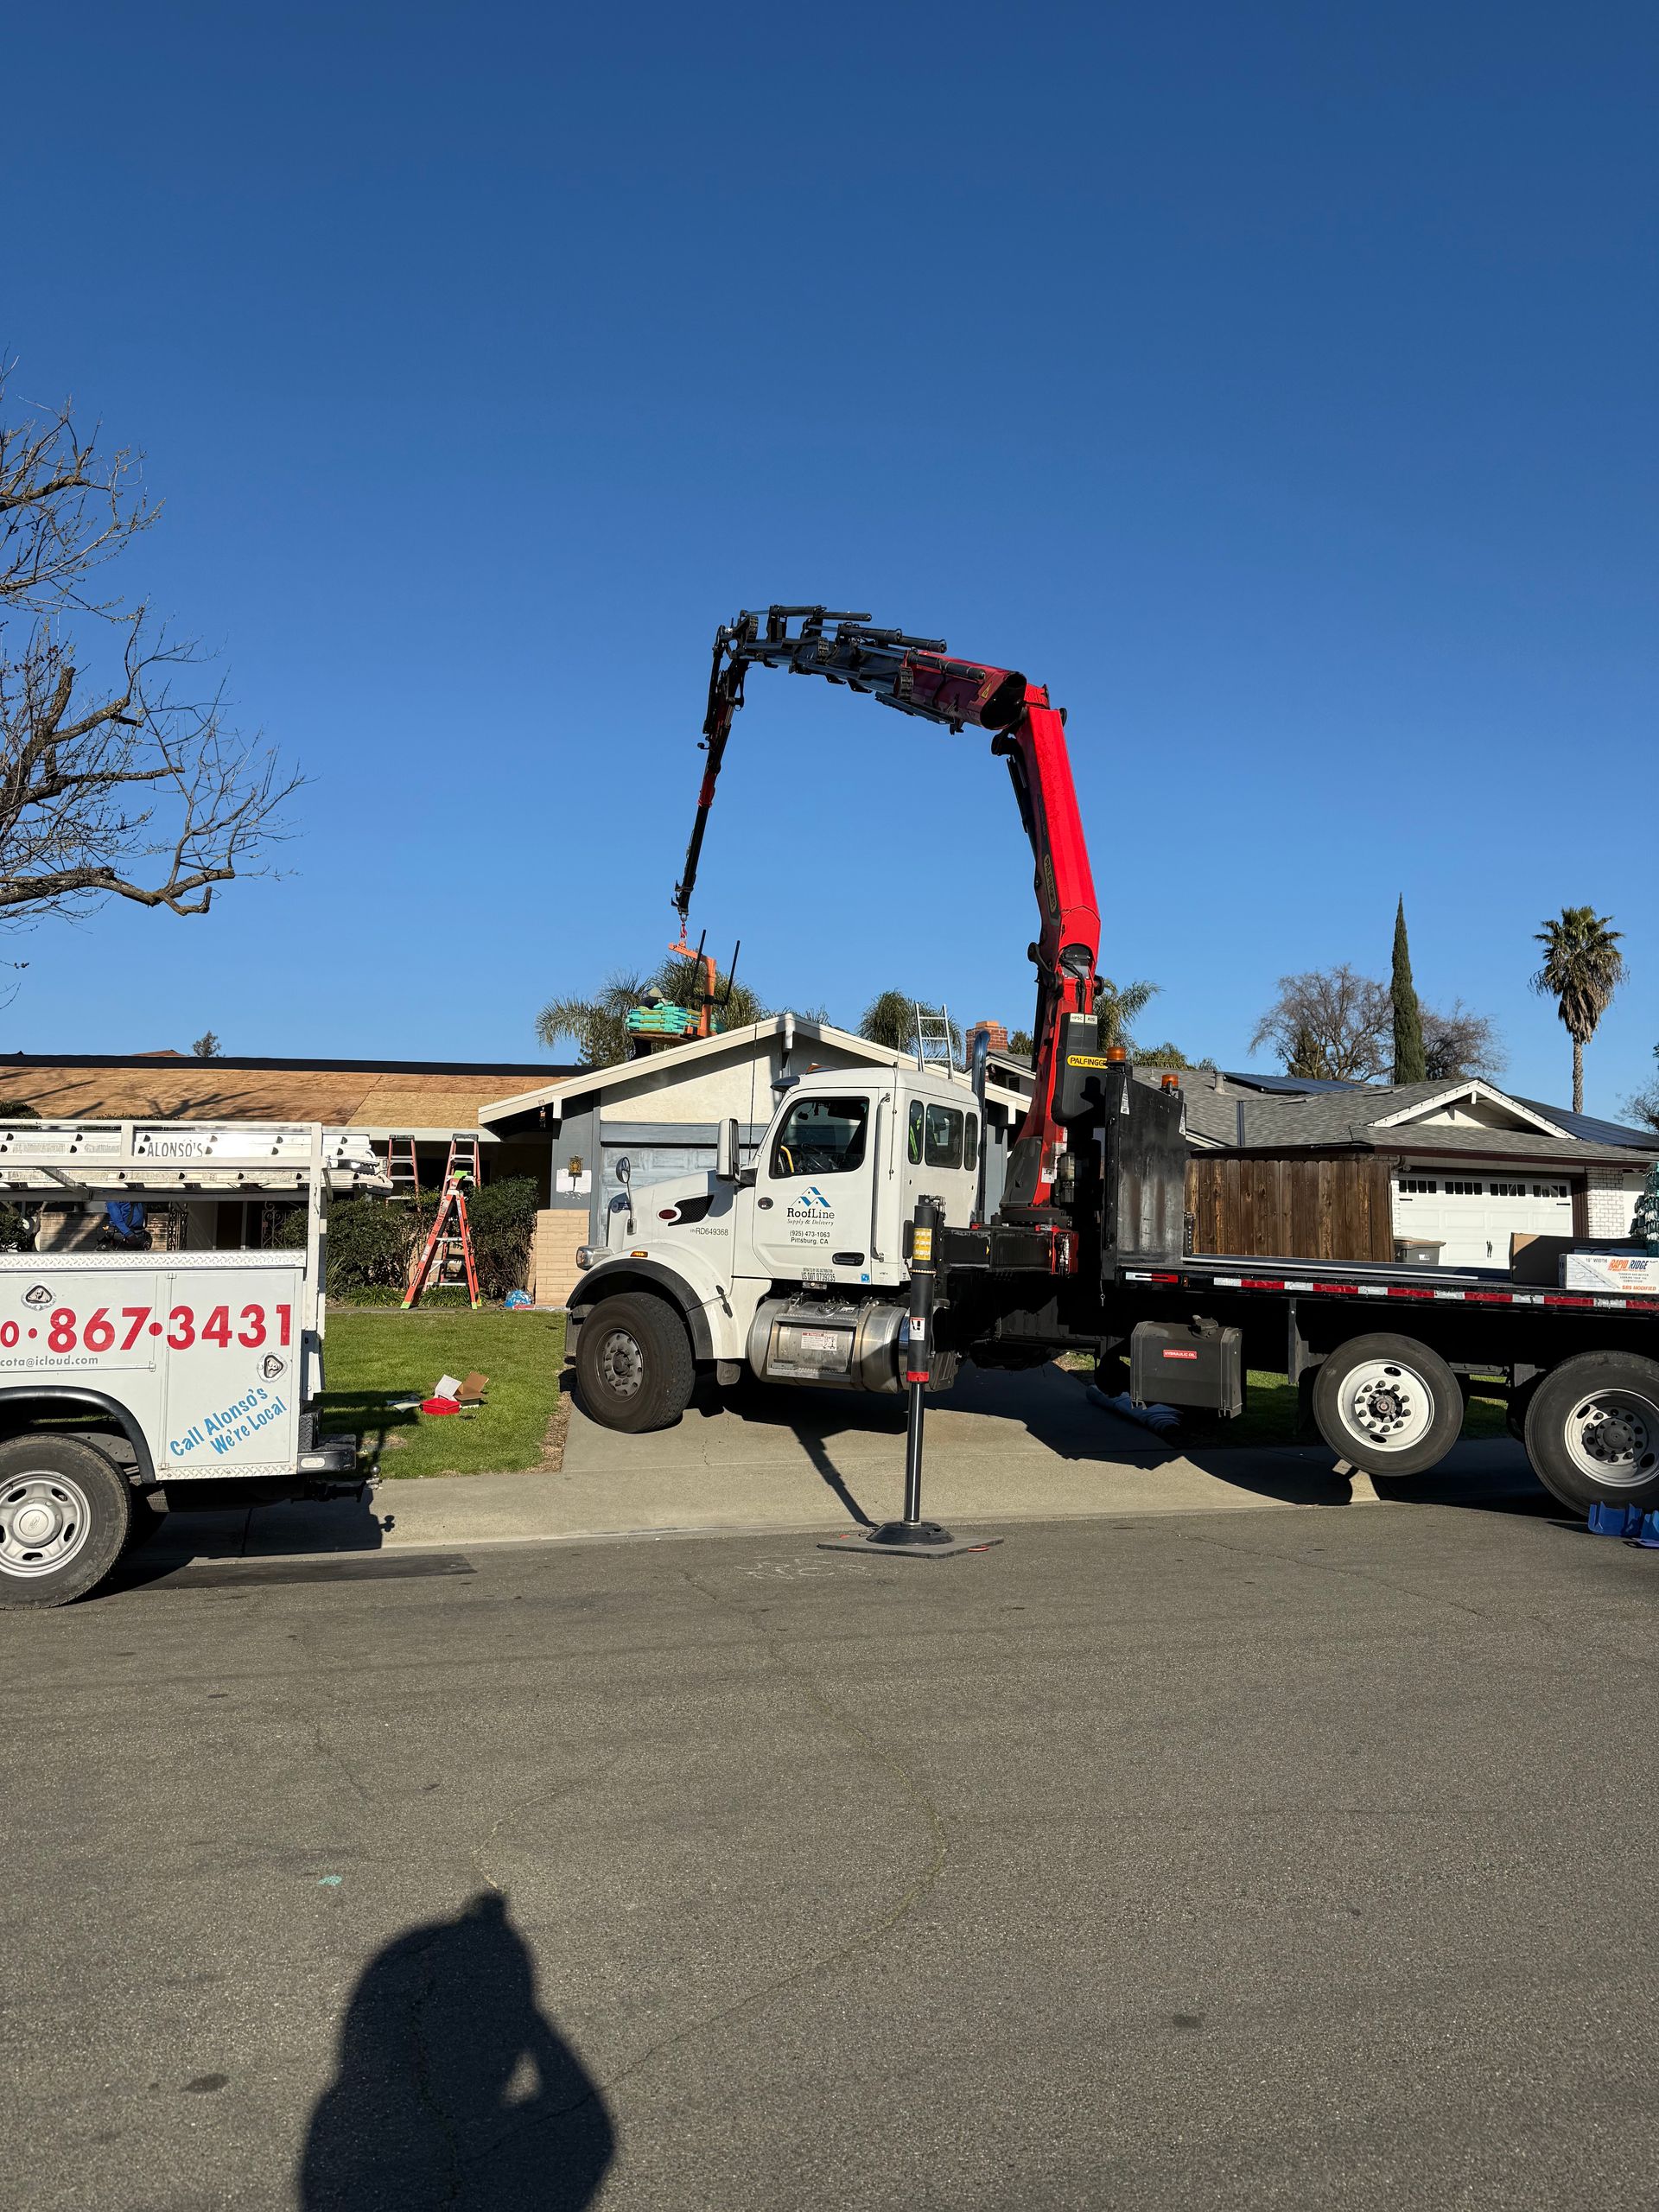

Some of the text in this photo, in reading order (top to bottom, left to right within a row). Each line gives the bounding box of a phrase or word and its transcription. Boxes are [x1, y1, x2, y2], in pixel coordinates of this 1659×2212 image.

[147, 1141, 203, 1157] ALONSO'S
[787, 1207, 835, 1219] RoofLine
[1608, 1258, 1649, 1270] RAPID RIDGE
[169, 1388, 268, 1456] Call Alonso's
[210, 1395, 287, 1454] We're Local
